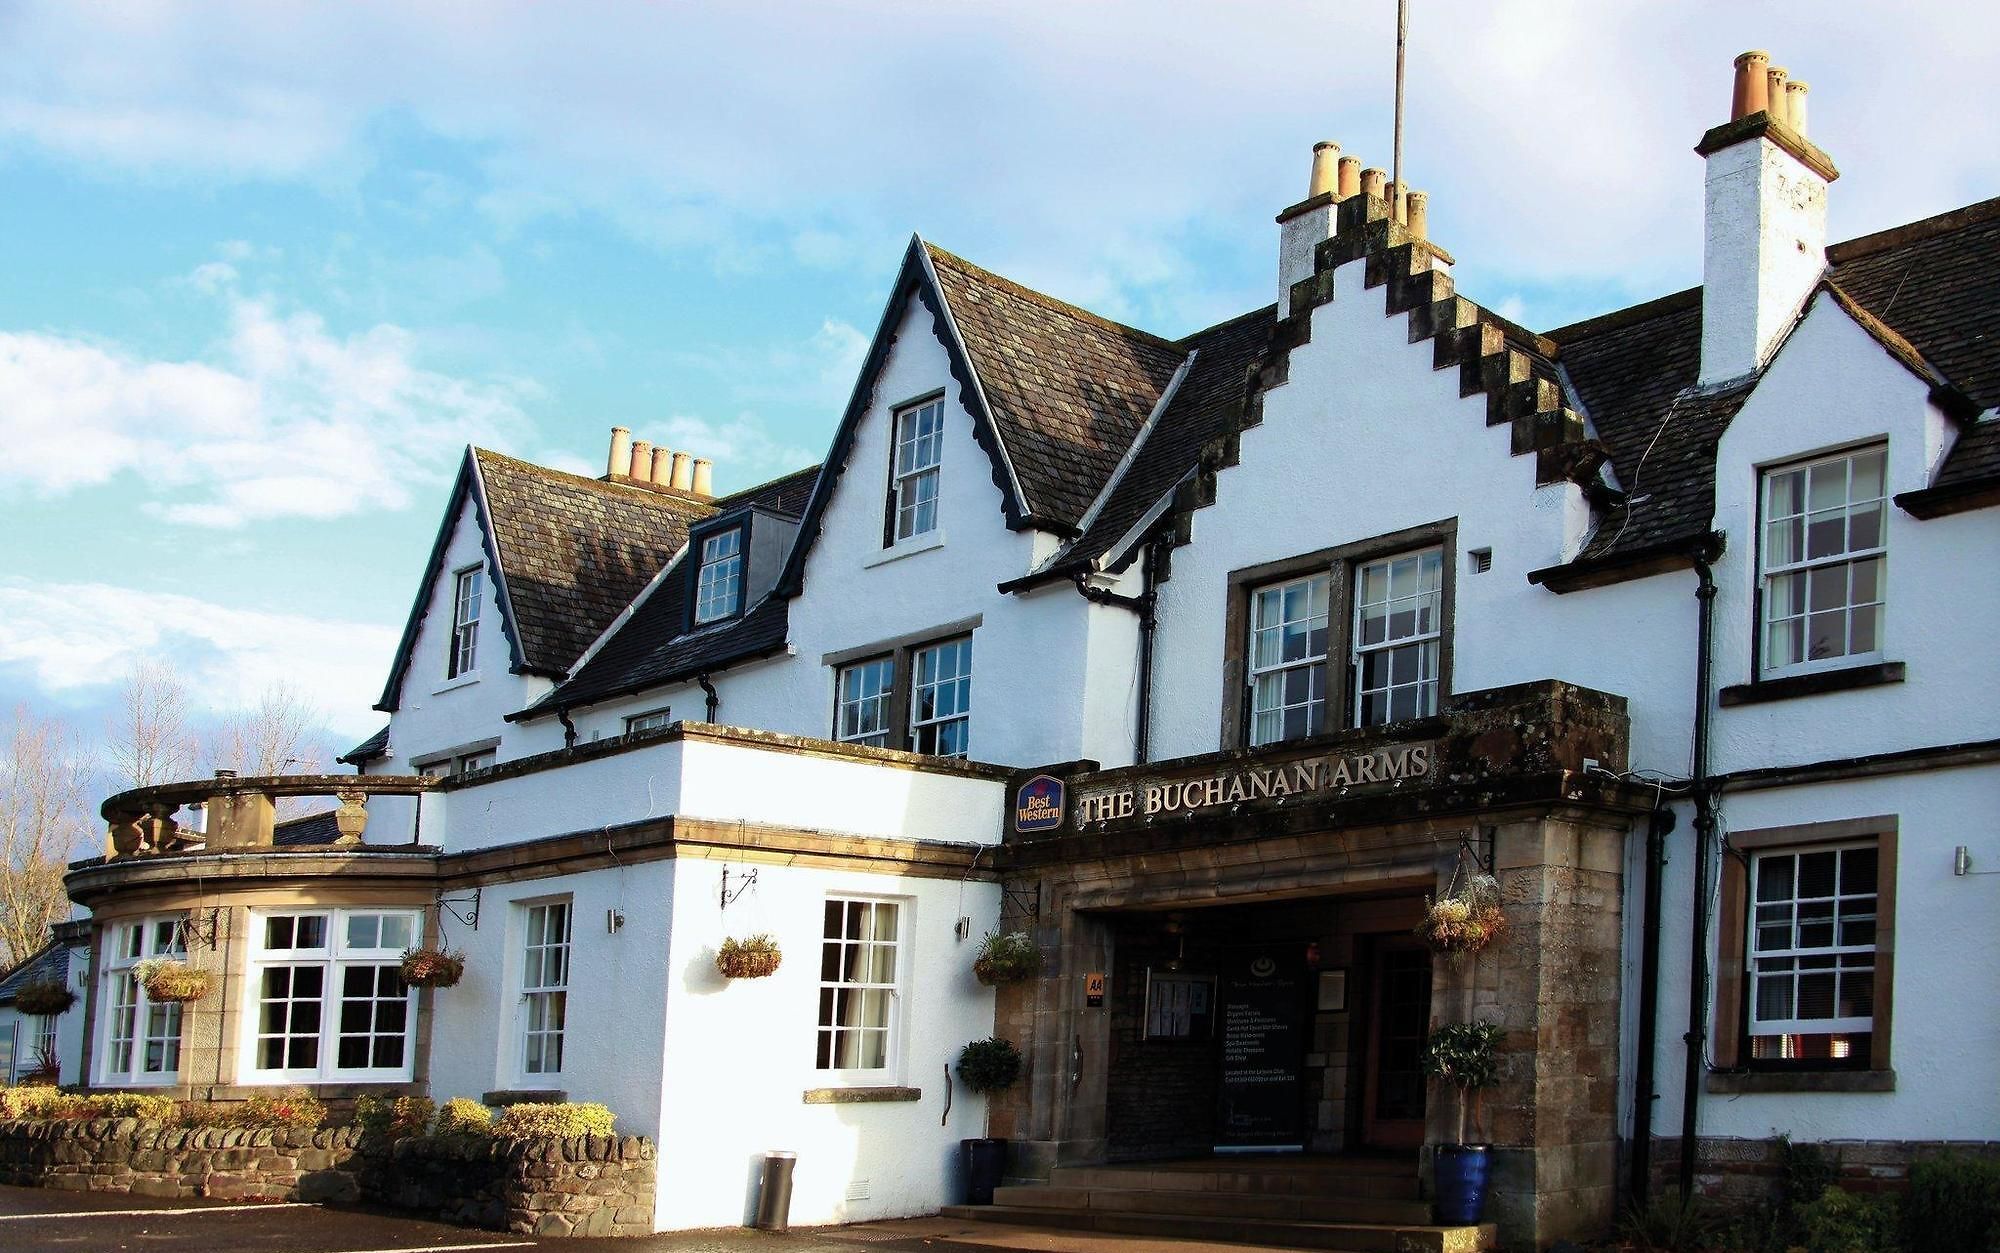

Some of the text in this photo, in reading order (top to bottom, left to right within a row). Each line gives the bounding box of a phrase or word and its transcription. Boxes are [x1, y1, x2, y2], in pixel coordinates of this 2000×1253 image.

[1080, 745, 1430, 823] THE BUCHANAN ARMS
[1028, 794, 1051, 810] Best
[1019, 807, 1059, 822] Western
[1090, 979, 1102, 991] AA
